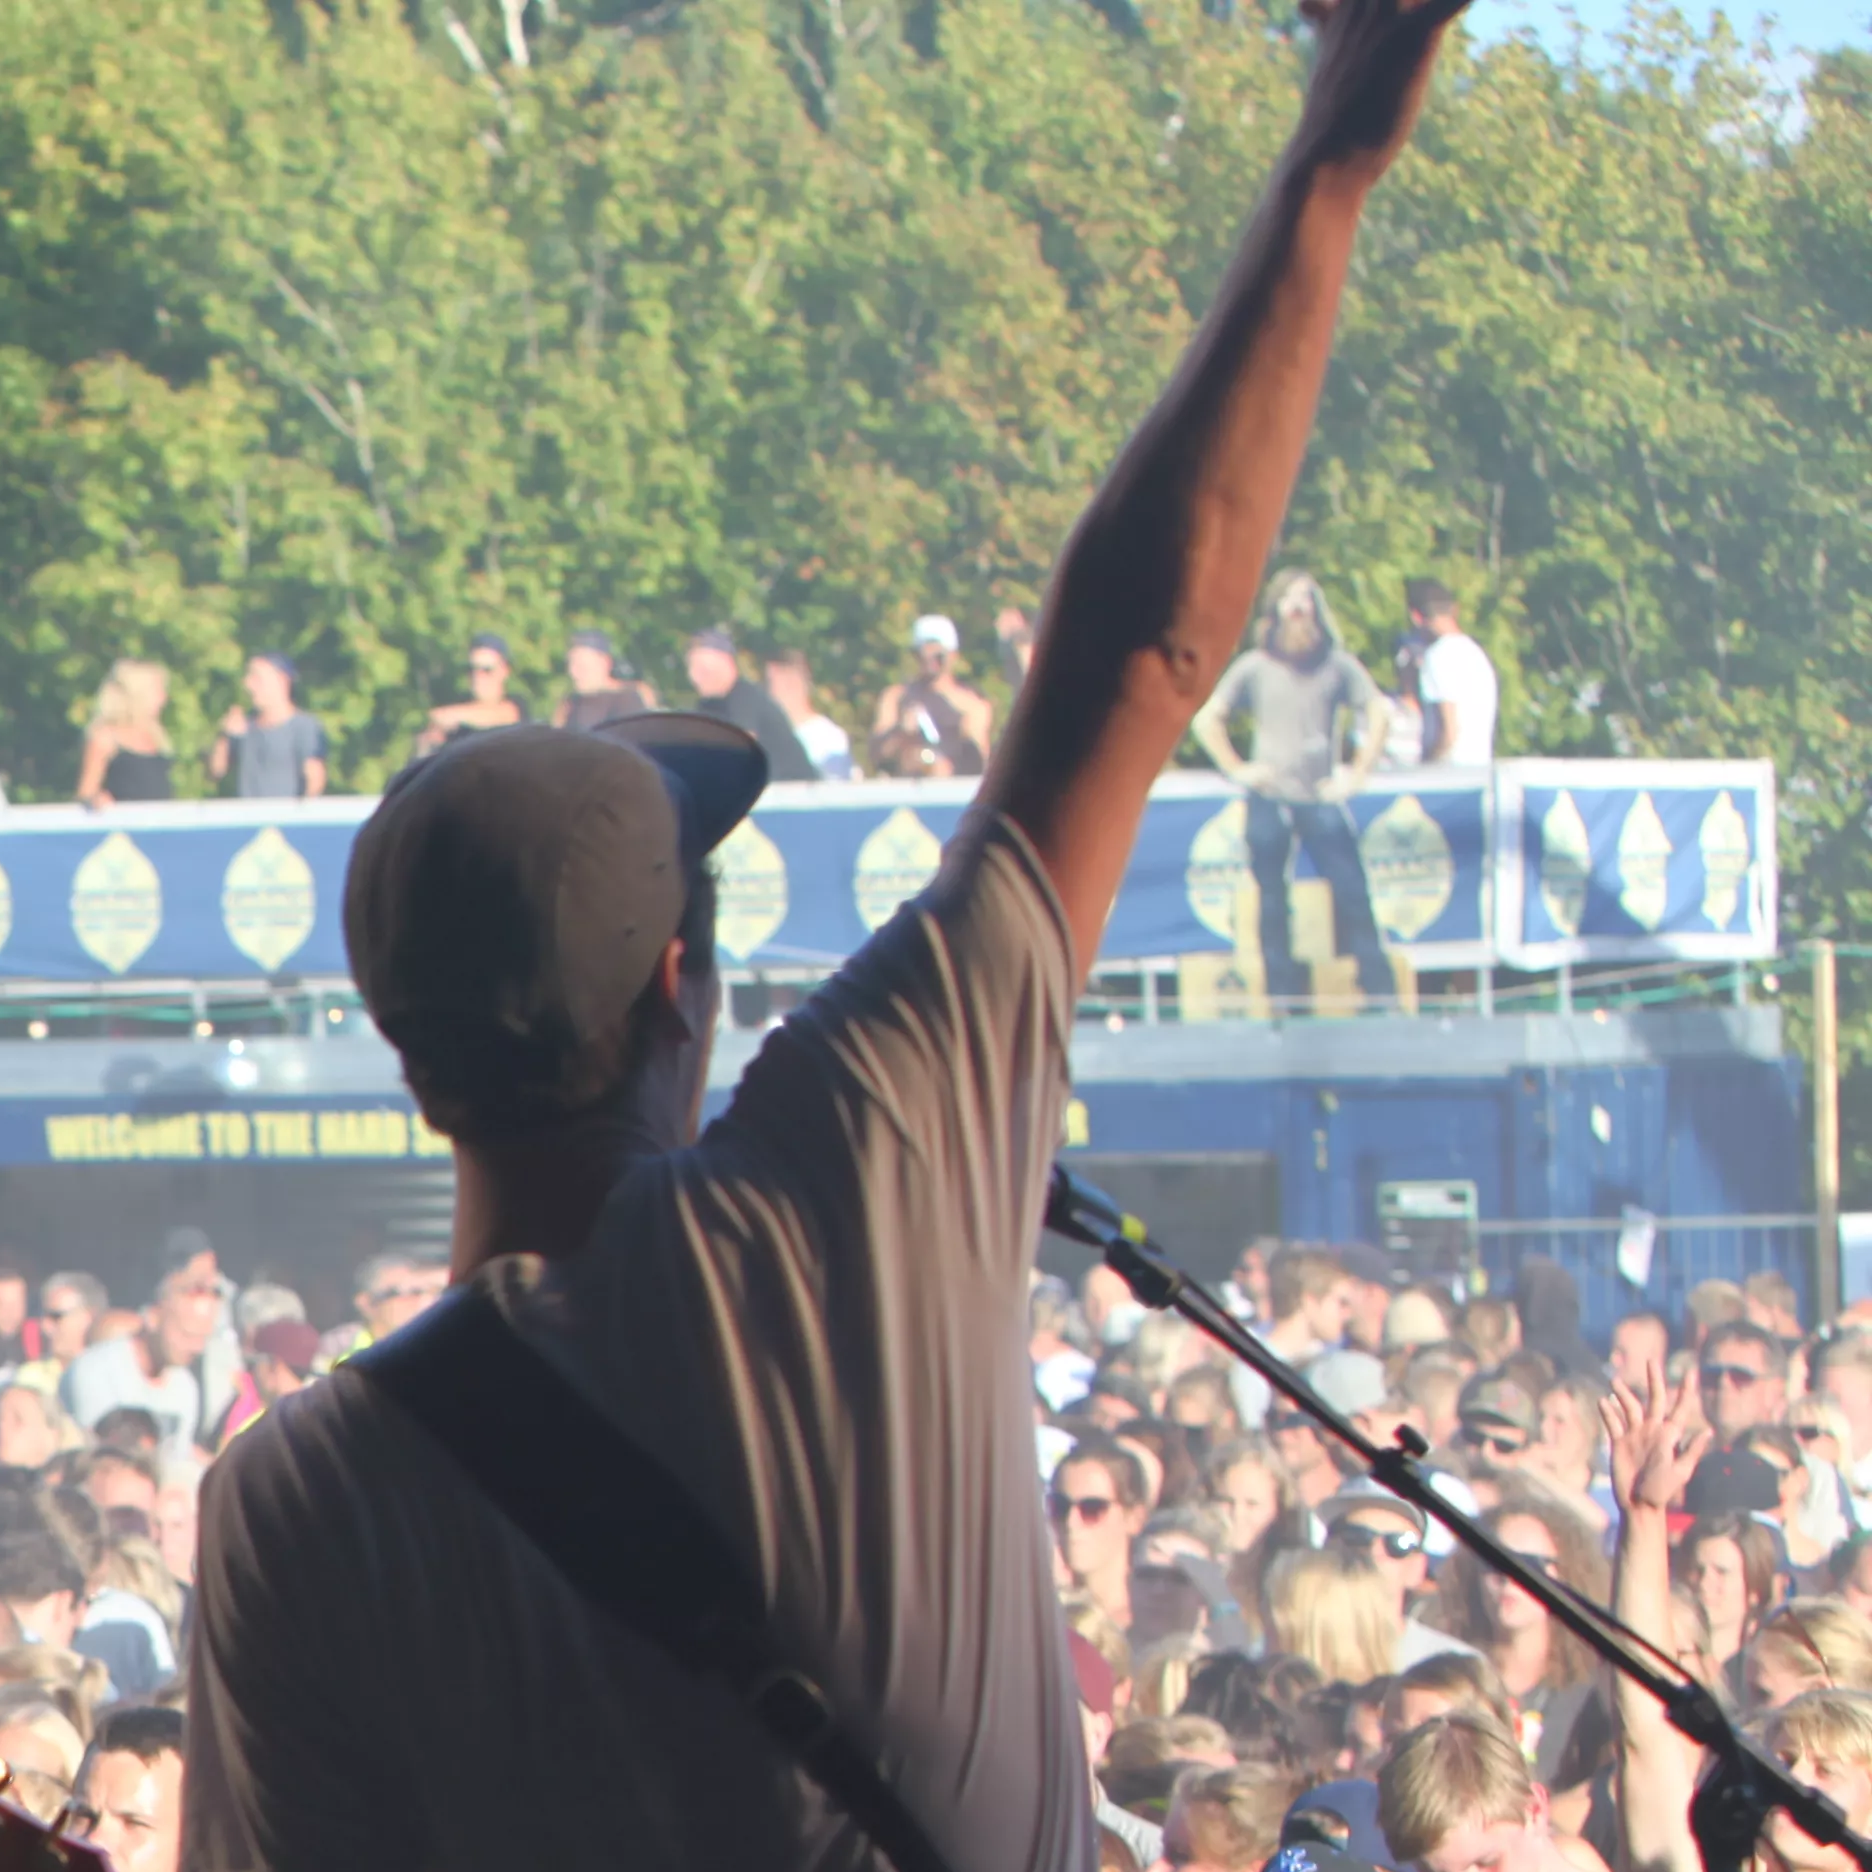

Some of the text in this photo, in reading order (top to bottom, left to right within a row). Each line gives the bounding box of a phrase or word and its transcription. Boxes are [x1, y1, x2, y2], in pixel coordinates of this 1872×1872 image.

[45, 1111, 204, 1161] WELCOME
[206, 1111, 252, 1160] TO
[254, 1110, 315, 1159] THE
